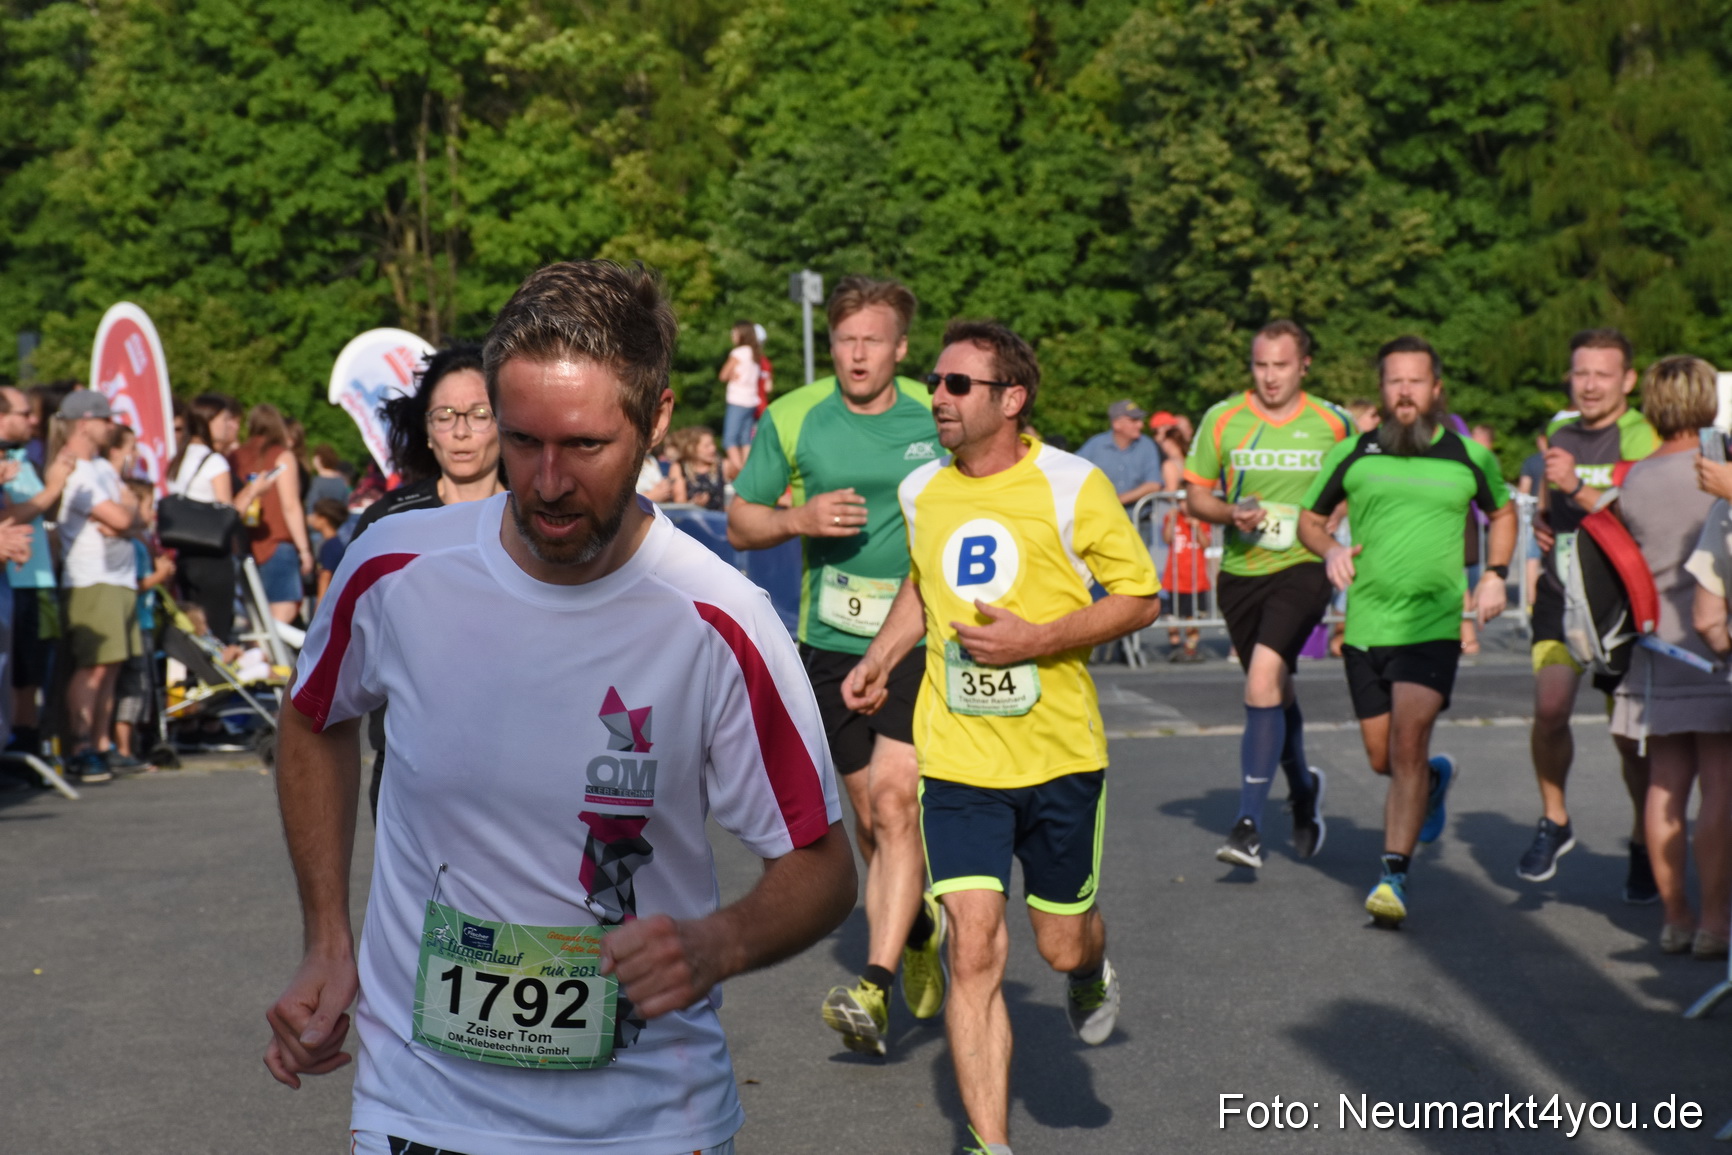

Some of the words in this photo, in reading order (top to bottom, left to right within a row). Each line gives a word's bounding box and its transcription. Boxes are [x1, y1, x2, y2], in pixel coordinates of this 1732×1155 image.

[956, 535, 997, 586] B
[848, 597, 861, 617] 9
[961, 670, 1017, 697] 354
[586, 755, 658, 791] OM
[586, 786, 617, 796] KLEBE
[618, 789, 655, 798] TECHNIK
[569, 965, 601, 977] 201
[441, 964, 590, 1029] 1792
[447, 1031, 534, 1053] OM-Klebetechnik
[537, 1046, 570, 1056] GmbH
[466, 1021, 514, 1040] Zeiser
[518, 1029, 552, 1044] Tom
